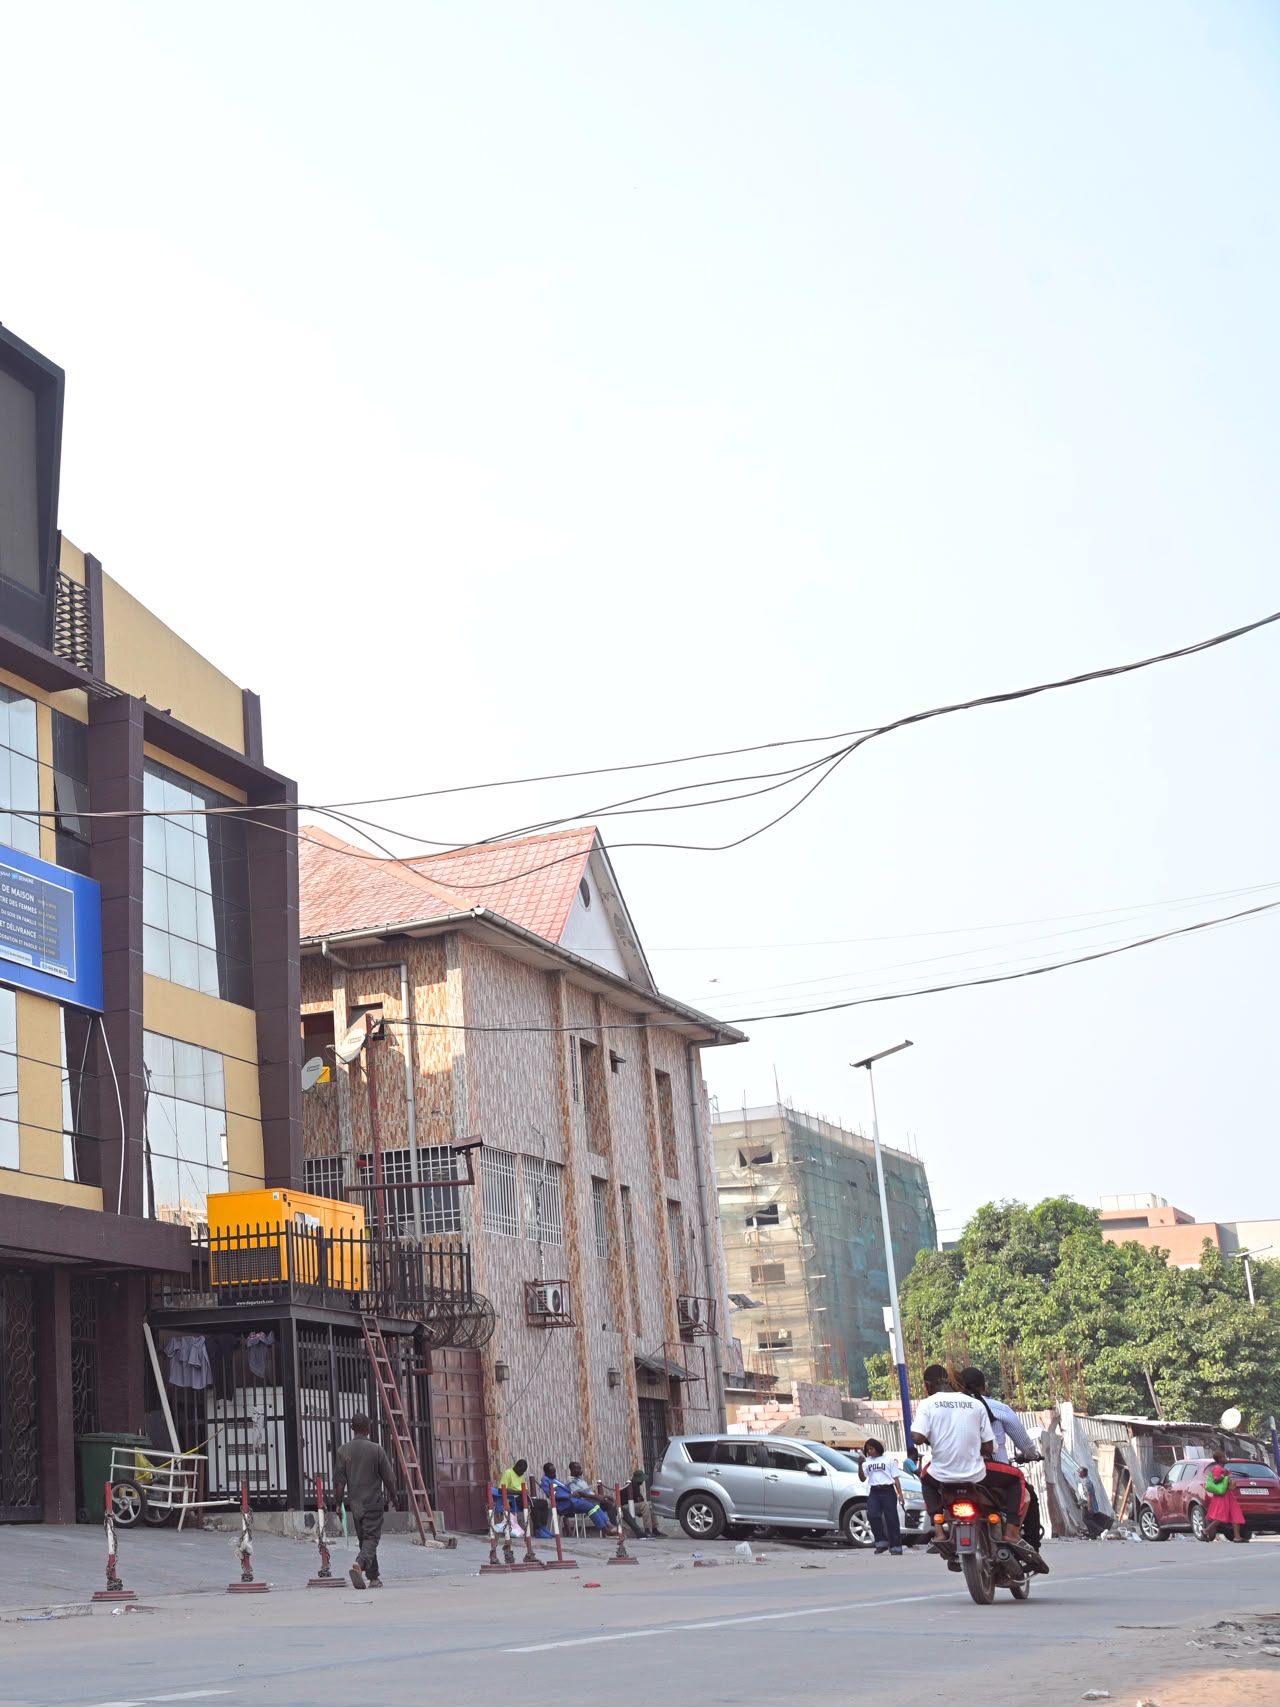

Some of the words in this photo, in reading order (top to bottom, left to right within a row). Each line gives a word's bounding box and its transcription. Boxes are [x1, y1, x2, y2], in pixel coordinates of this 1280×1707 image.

[1, 883, 10, 893] DE
[11, 888, 35, 902] MAISON
[9, 898, 18, 907] DES
[18, 902, 38, 914] FEMMES
[0, 919, 6, 927] ET
[6, 921, 37, 939] DÉLIVRANCE
[867, 1462, 886, 1472] POLO
